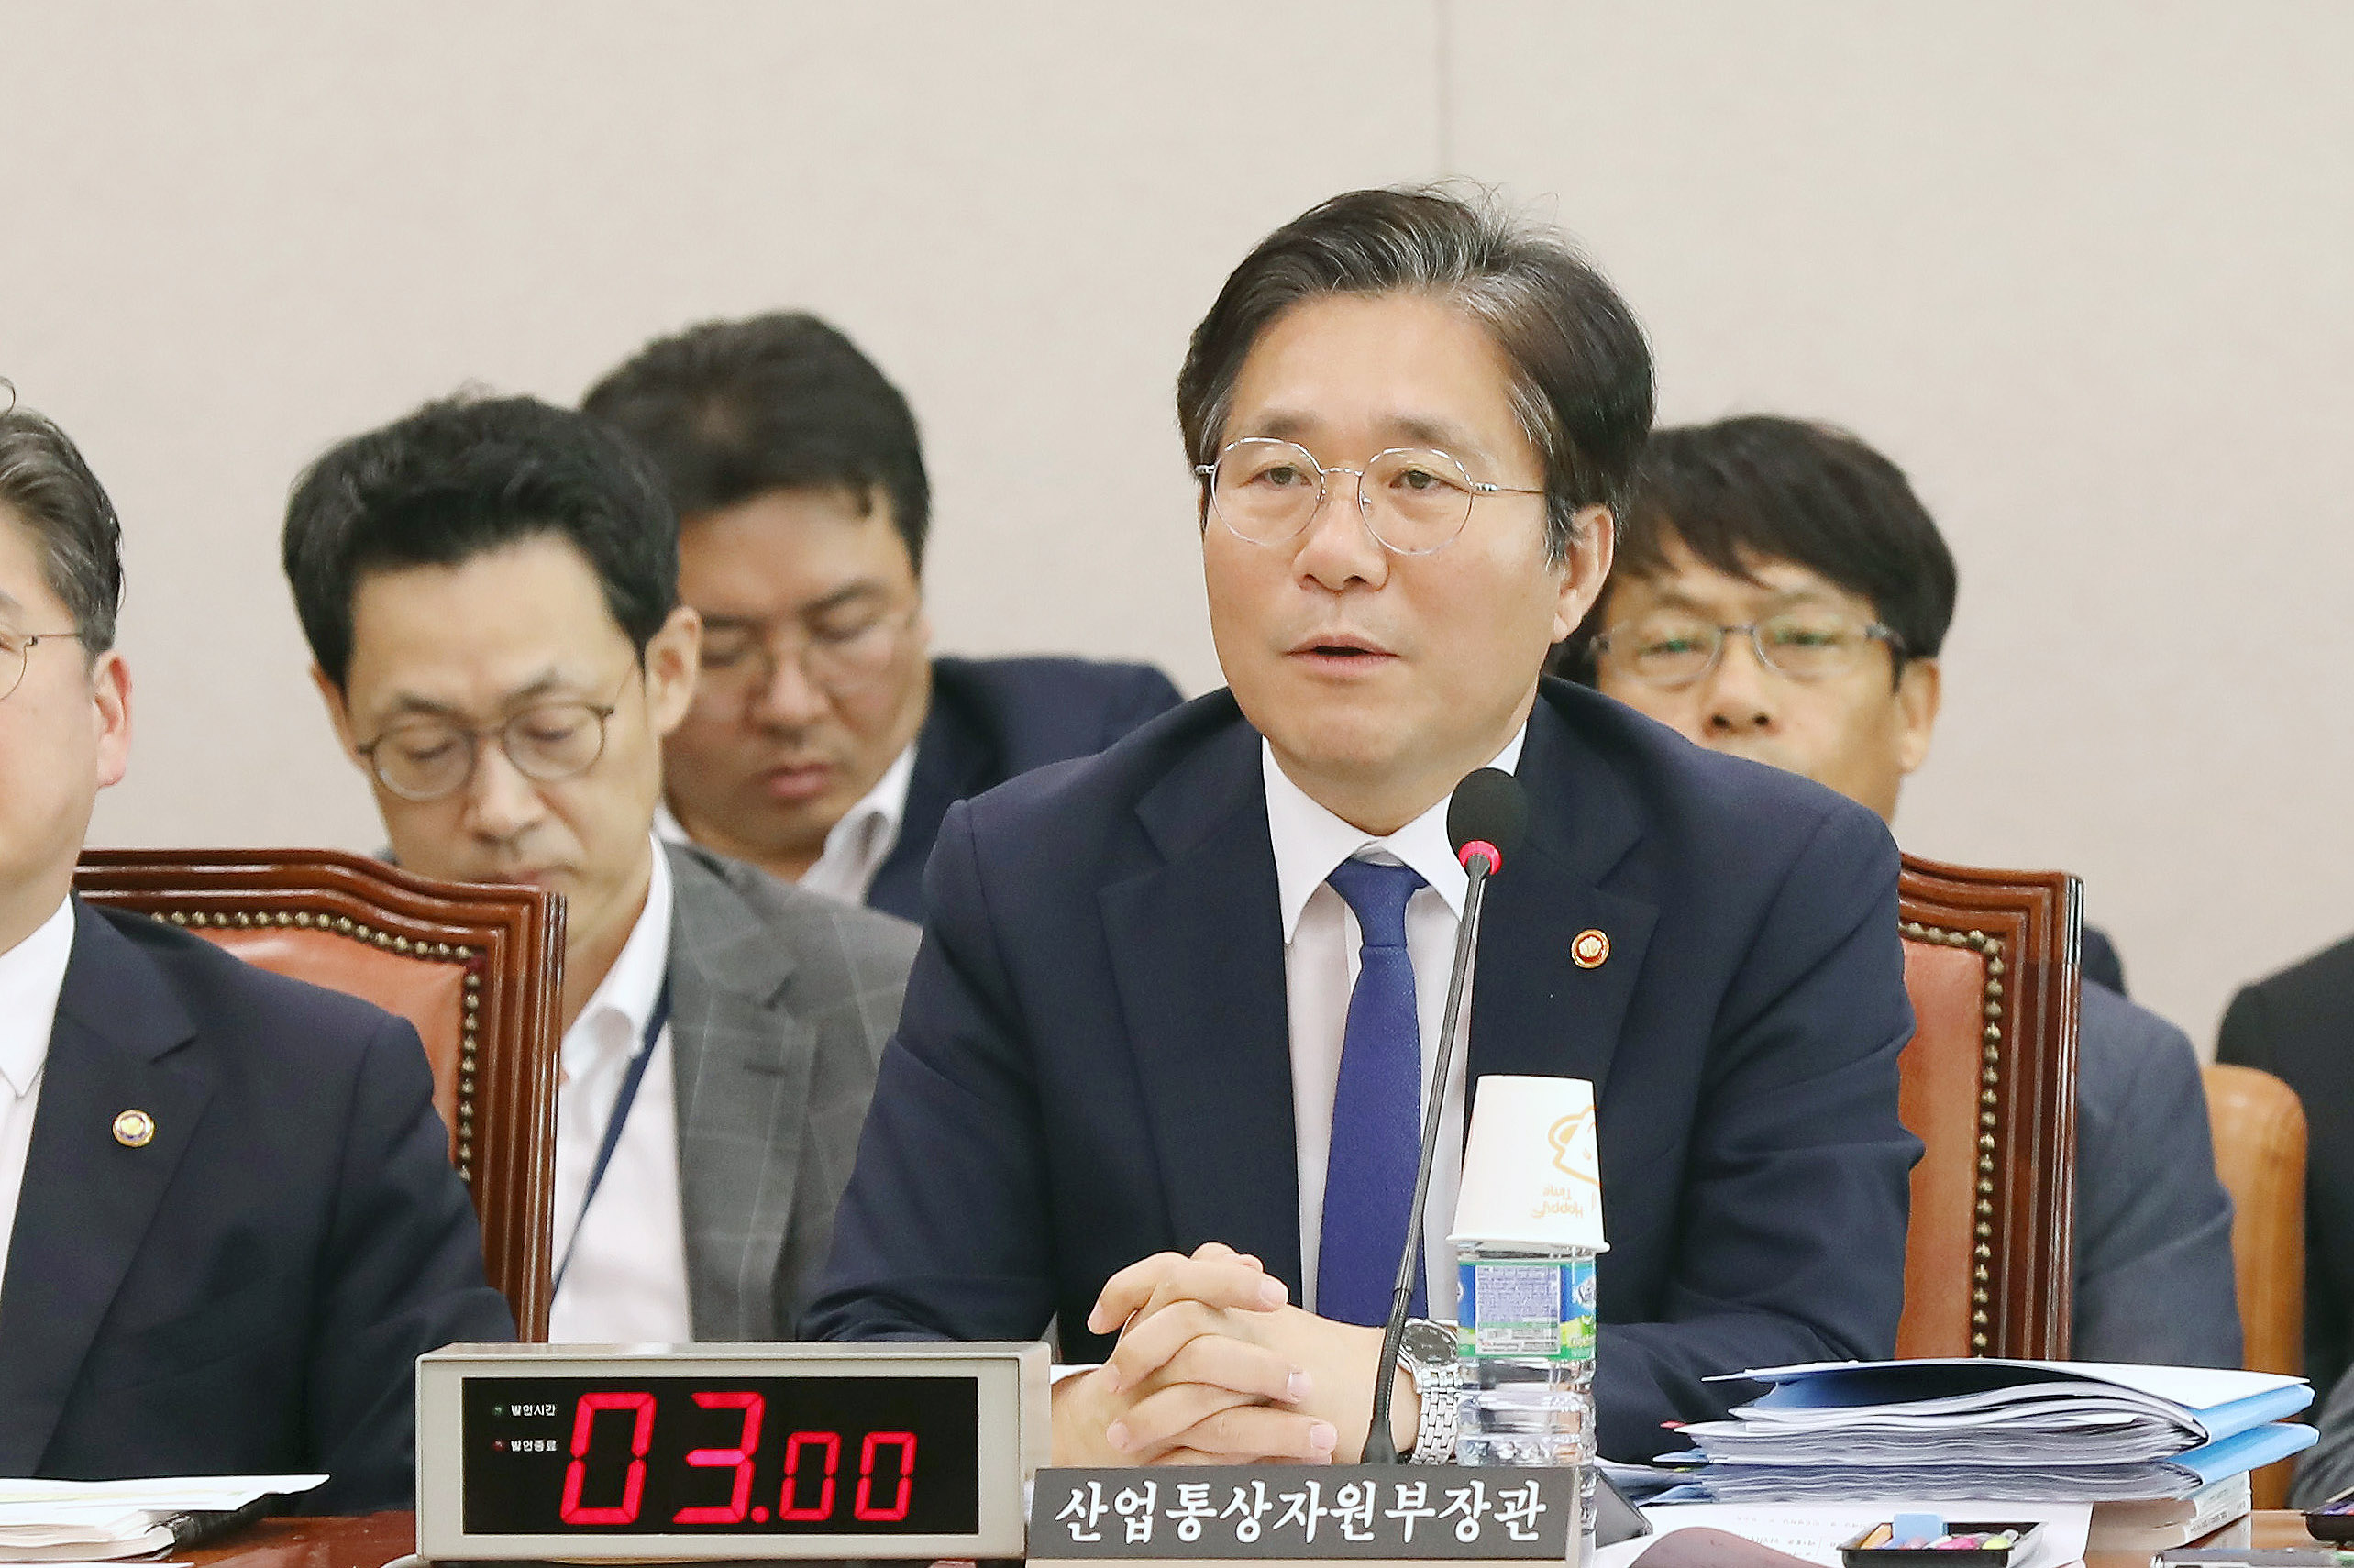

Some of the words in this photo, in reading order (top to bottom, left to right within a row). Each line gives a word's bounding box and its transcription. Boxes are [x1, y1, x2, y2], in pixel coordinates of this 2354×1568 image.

[511, 1404, 556, 1417] 발언시간
[511, 1440, 558, 1452] 발언종료
[1055, 1479, 1547, 1544] 산업통상자원부장관
